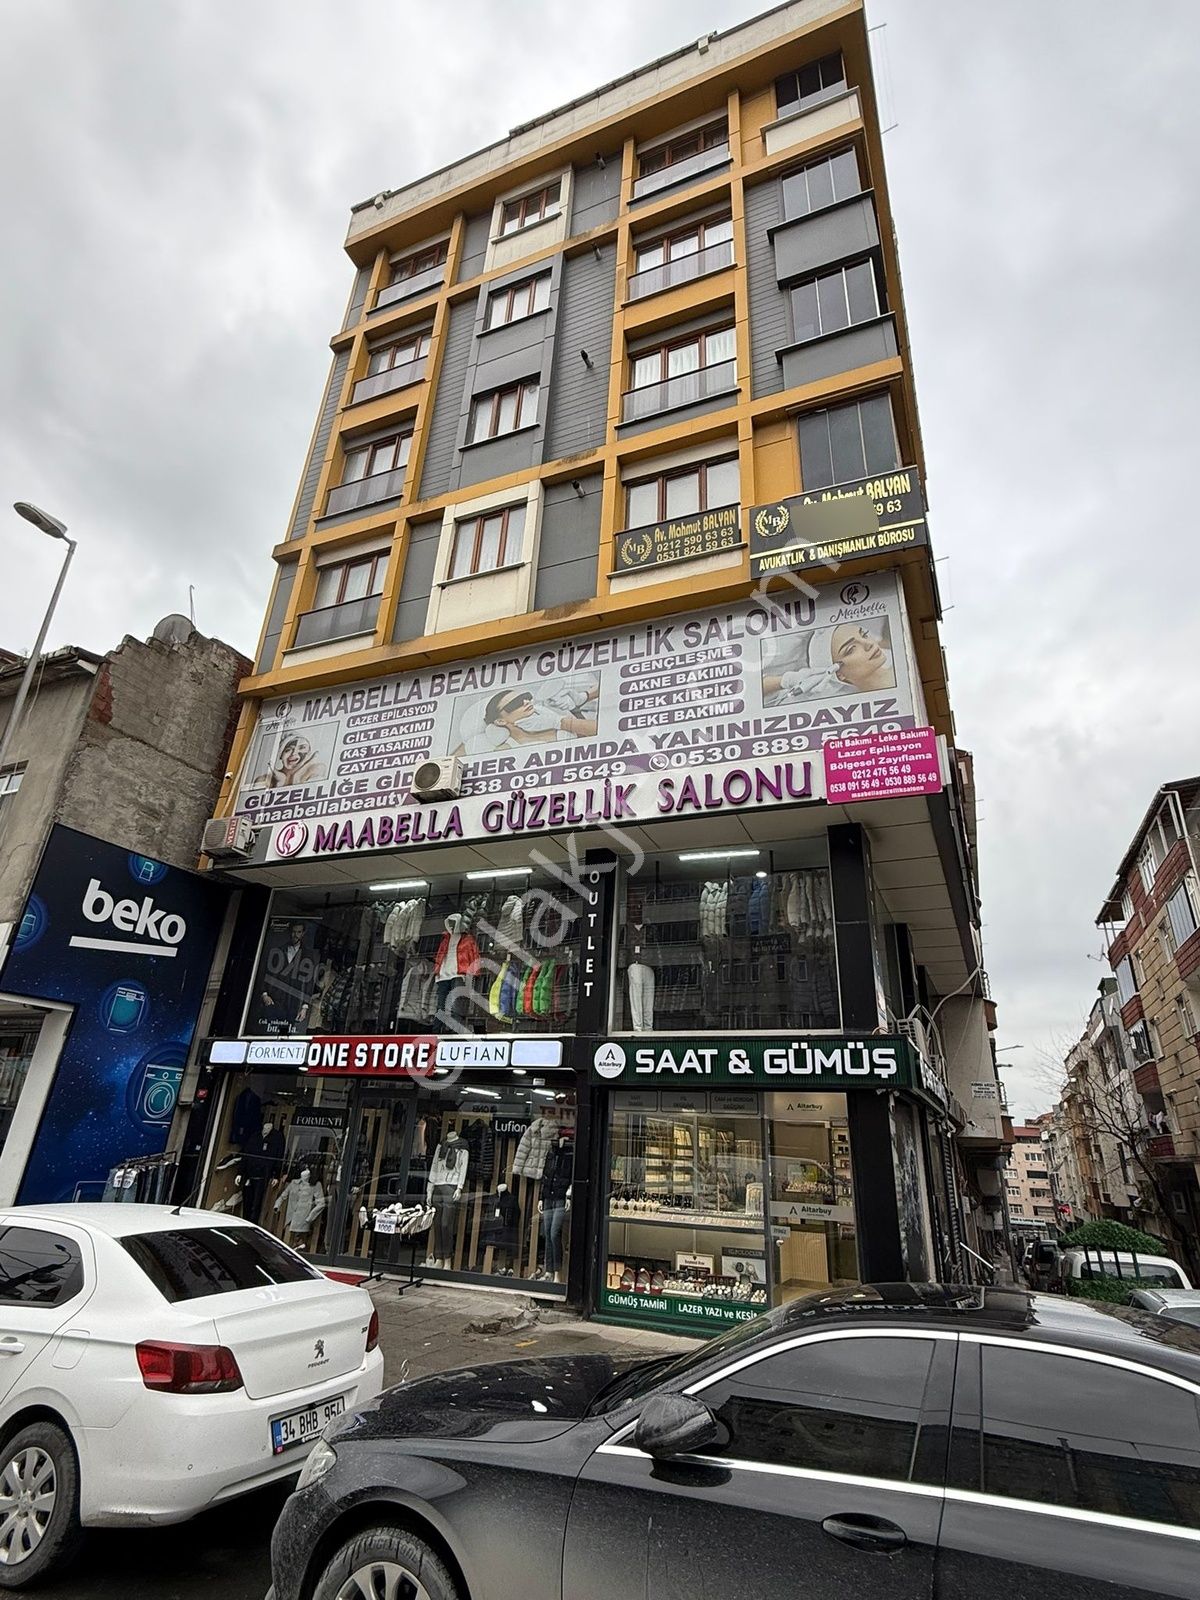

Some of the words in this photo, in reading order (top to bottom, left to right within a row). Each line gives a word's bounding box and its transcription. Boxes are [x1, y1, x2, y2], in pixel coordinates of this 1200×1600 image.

[866, 473, 911, 500] BALYAN
[888, 499, 902, 513] 63
[654, 528, 667, 542] Av.
[669, 521, 701, 540] Mahmut
[703, 509, 736, 530] BALYAN
[656, 540, 681, 552] 0212
[684, 534, 702, 547] 590
[705, 531, 718, 541] 63
[721, 527, 734, 536] 63
[656, 549, 680, 562] 0531
[684, 545, 702, 557] 824
[706, 540, 718, 550] 59
[721, 537, 734, 546] 63
[759, 552, 805, 571] AVUKATLIK
[809, 549, 815, 561] &
[817, 534, 877, 559] DANIŞMANLIK
[878, 527, 915, 546] BÜROSU
[829, 602, 886, 623] Maabella
[302, 678, 423, 722] MAABELLA
[429, 655, 533, 698] BEAUTY
[537, 624, 675, 677] GÜZELLİK
[682, 598, 816, 649] SALONU
[629, 645, 733, 669] GENÇLEŞME
[628, 676, 671, 693] AKNE
[676, 665, 733, 684] BAKIMI
[628, 695, 667, 711] İPEK
[673, 684, 733, 704] KİRPİK
[349, 713, 382, 727] LAZER
[381, 704, 435, 721] EPİLASYON
[627, 713, 669, 729] LEKE
[674, 702, 735, 721] BAKIMI
[346, 730, 377, 744] CİLT
[380, 721, 432, 738] BAKIMI
[830, 740, 843, 749] Cilt
[845, 738, 872, 748] Bakımı
[879, 734, 898, 743] Leke
[900, 730, 929, 740] Bakımı
[244, 777, 370, 810] GÜZELLİĞE
[463, 757, 517, 778] HER
[524, 738, 640, 769] ADIMDA
[648, 698, 899, 751] YANINIZDAYIZ
[343, 747, 368, 760] KAŞ
[371, 737, 429, 752] TASARIMI
[838, 750, 867, 758] Lazer
[869, 742, 922, 754] Epilasyon
[340, 753, 425, 775] ZAYIFLAMA
[830, 759, 875, 771] Bölgesel
[878, 753, 933, 765] Zayıflama
[852, 769, 871, 779] 0212
[873, 767, 887, 777] 476
[889, 765, 900, 775] 56
[901, 764, 911, 773] 49
[255, 791, 408, 825] maabellabeauty
[460, 779, 502, 796] 538
[510, 771, 552, 790] 091
[562, 761, 627, 782] 5649
[670, 745, 742, 767] 0530
[751, 735, 809, 756] 889
[830, 783, 846, 793] 0538
[847, 781, 859, 791] 091
[861, 780, 870, 789] 56
[871, 779, 880, 788] 49
[885, 777, 902, 787] 0530
[903, 775, 916, 785] 889
[918, 773, 927, 783] 56
[928, 772, 937, 782] 49
[313, 805, 464, 854] MAABELLA
[482, 778, 638, 833] GÜZELLİK
[657, 761, 813, 813] SALONU
[82, 877, 187, 945] beko
[583, 870, 600, 997] OUTLET
[249, 1045, 305, 1060] FORMENTI
[308, 1043, 350, 1067] ONE
[354, 1043, 430, 1067] STORE
[439, 1046, 506, 1062] LUFIAN
[635, 1048, 718, 1074] SAAT
[728, 1048, 754, 1074] &
[764, 1041, 897, 1079] GÜMÜŞ
[797, 1102, 823, 1110] Altarbuy
[296, 1116, 343, 1126] FORMENTI
[495, 1120, 527, 1132] Lufian
[801, 1206, 832, 1216] Altarbuy
[608, 1294, 638, 1308] GÜMÜŞ
[639, 1298, 667, 1310] TAMİRİ
[678, 1303, 703, 1315] LAZER
[704, 1307, 722, 1317] YAZI
[724, 1311, 734, 1319] ve
[282, 1419, 295, 1442] 34
[299, 1410, 319, 1435] BHB
